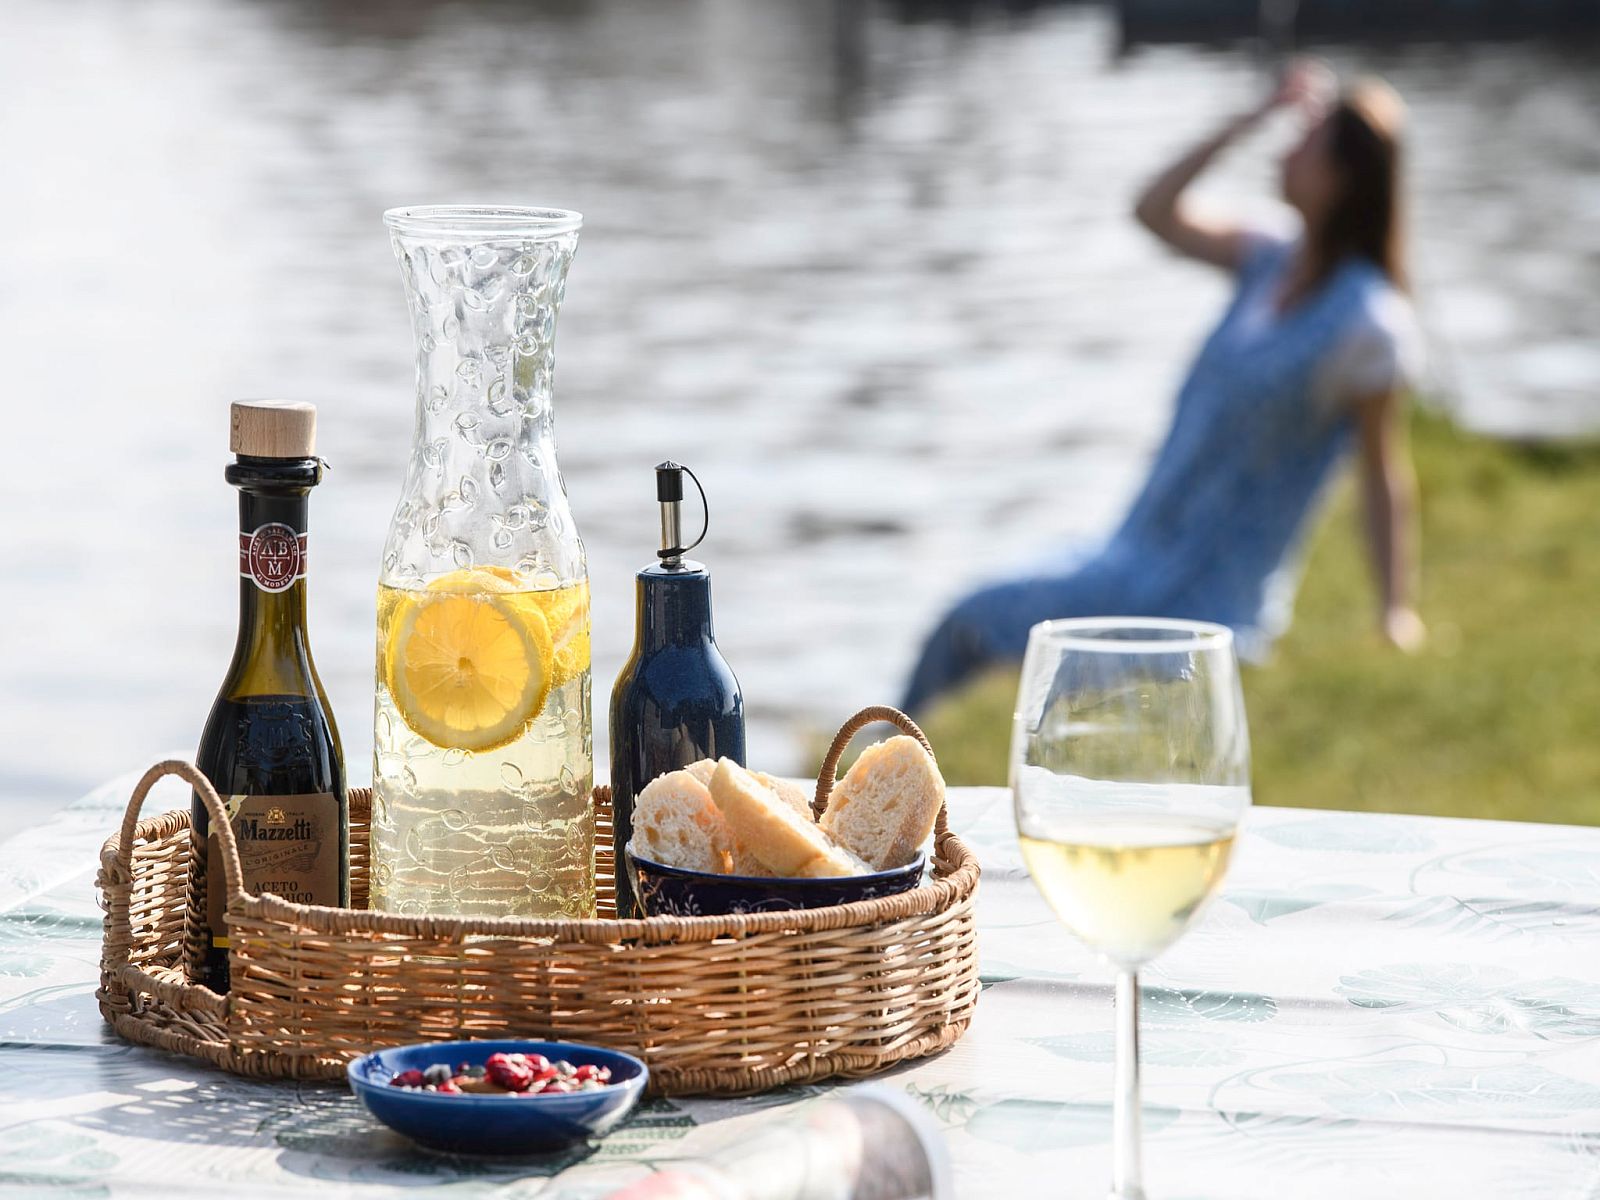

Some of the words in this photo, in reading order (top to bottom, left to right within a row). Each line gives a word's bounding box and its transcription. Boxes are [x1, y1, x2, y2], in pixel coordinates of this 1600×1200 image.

[264, 574, 293, 588] MODENA
[240, 819, 311, 841] Mazzetti
[253, 881, 298, 892] ACETO
